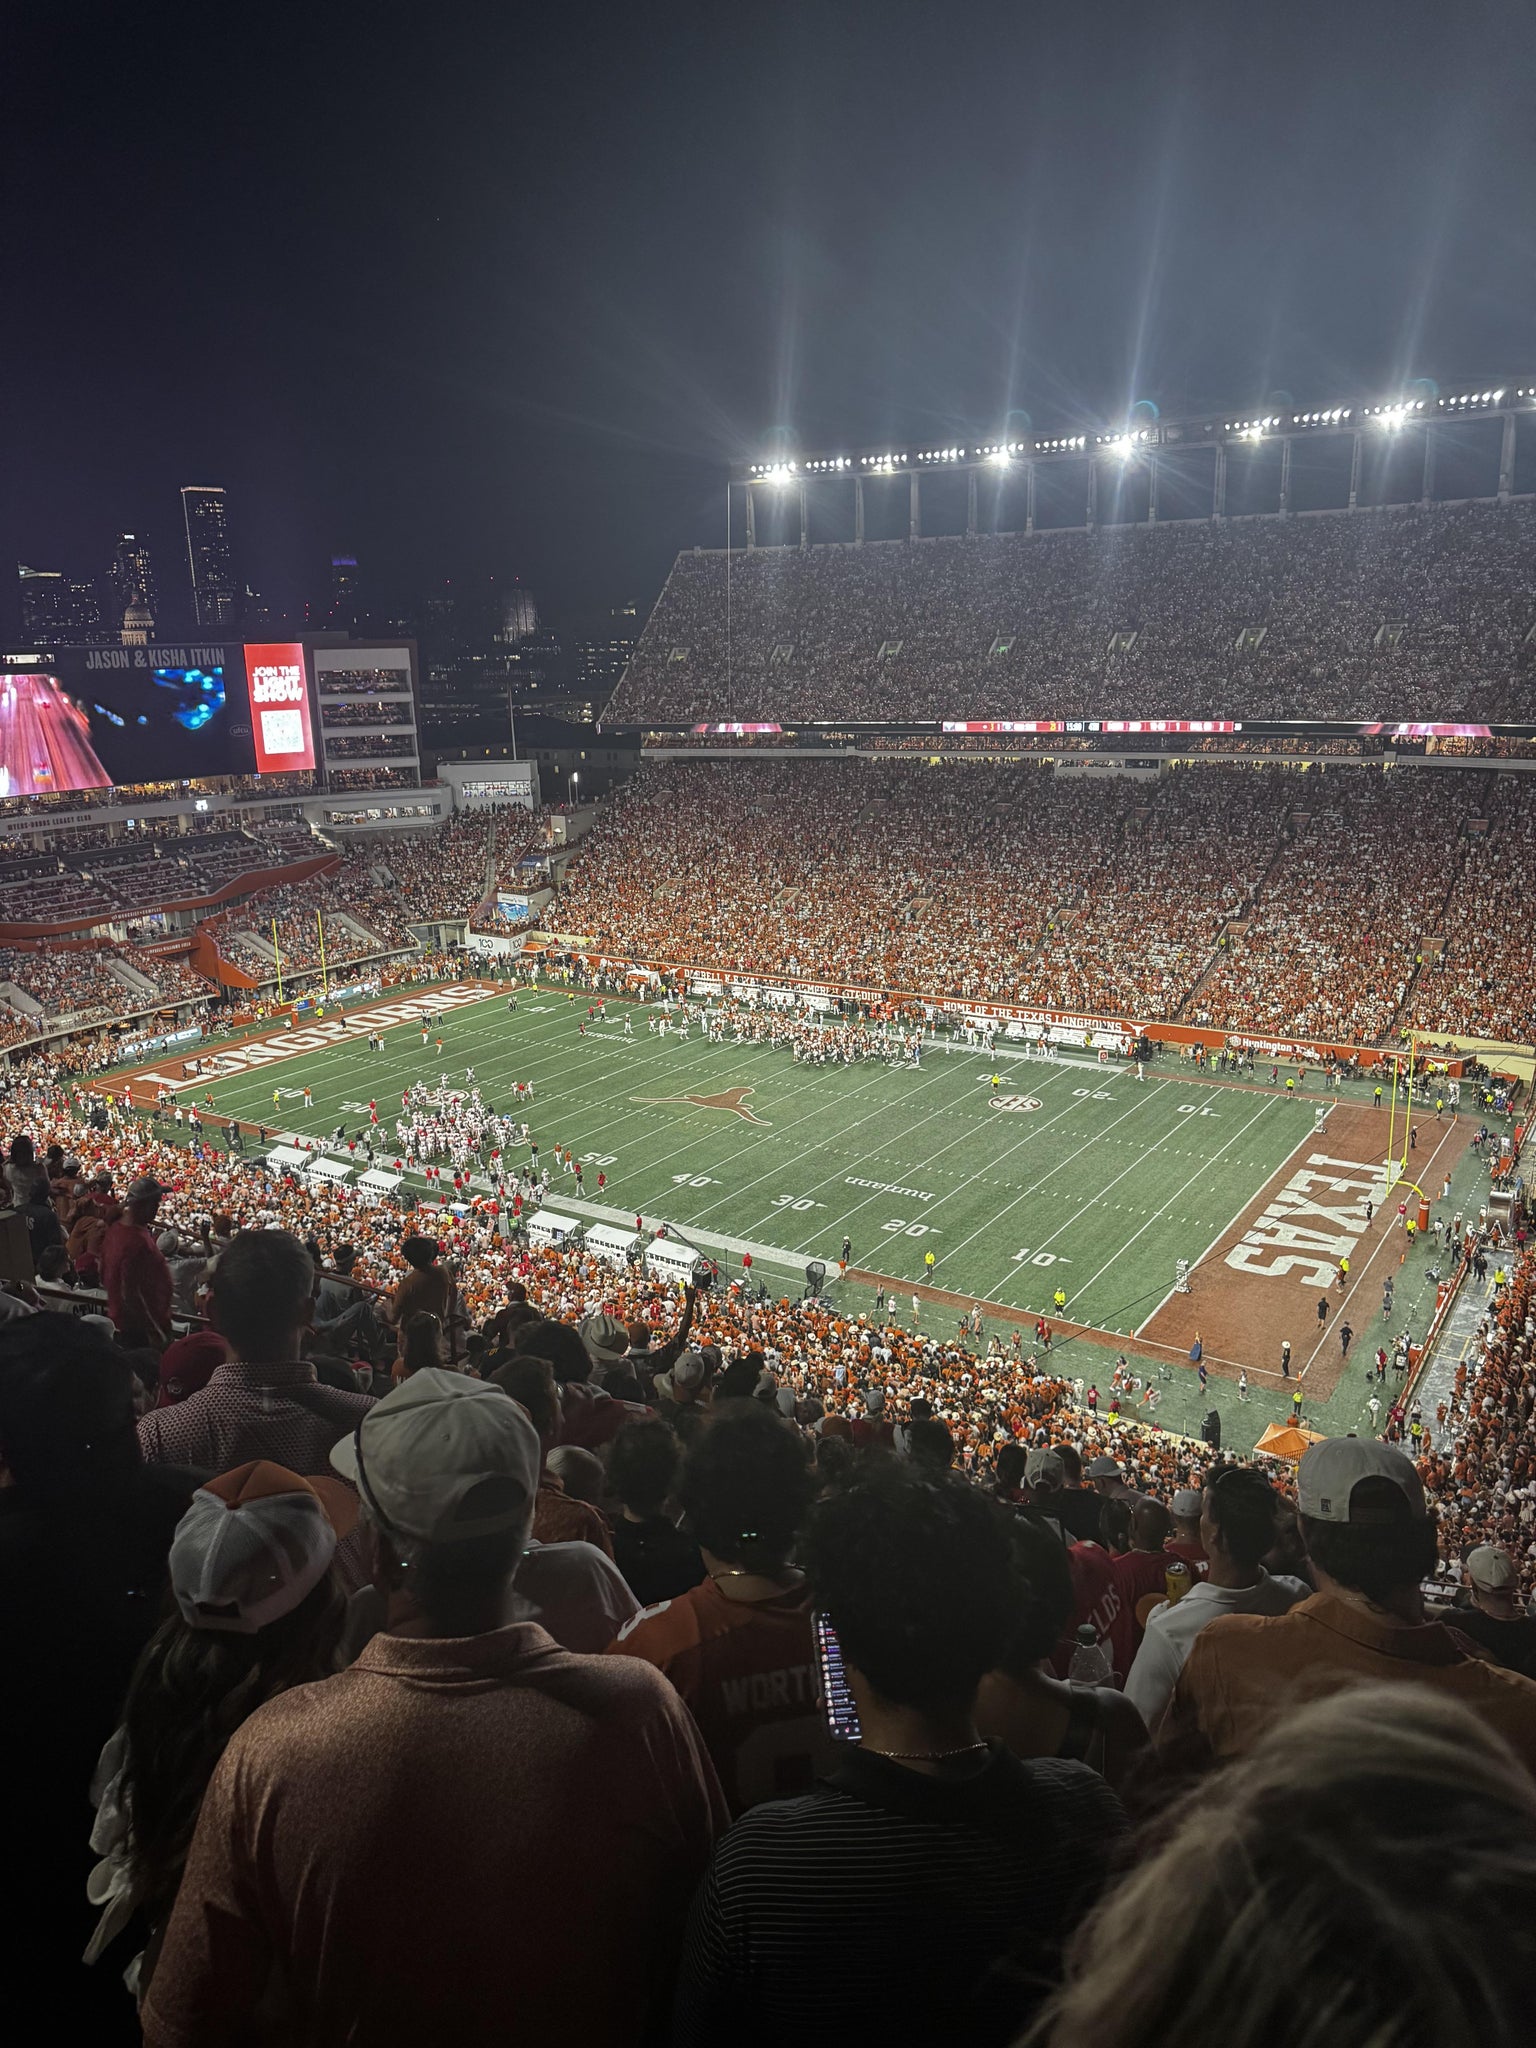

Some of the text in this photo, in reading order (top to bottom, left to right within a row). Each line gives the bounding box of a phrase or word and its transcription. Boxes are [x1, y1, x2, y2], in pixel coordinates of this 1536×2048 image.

[86, 648, 225, 669] JASON & KISHA ITKIN
[252, 665, 301, 677] JOIN THE
[253, 687, 303, 703] SHOW
[943, 1001, 1122, 1031] HOME OF THE TEXAS LONGHORNS
[133, 985, 496, 1089] LONGHORNS
[1243, 1038, 1292, 1053] Huntington
[1071, 1088, 1111, 1100] 20
[1176, 1104, 1213, 1116] 10
[578, 1152, 618, 1166] 50
[671, 1173, 712, 1187] 40
[770, 1195, 815, 1211] 30
[880, 1219, 929, 1237] 20
[1224, 1152, 1403, 1289] TEXAS
[1011, 1248, 1057, 1266] 10
